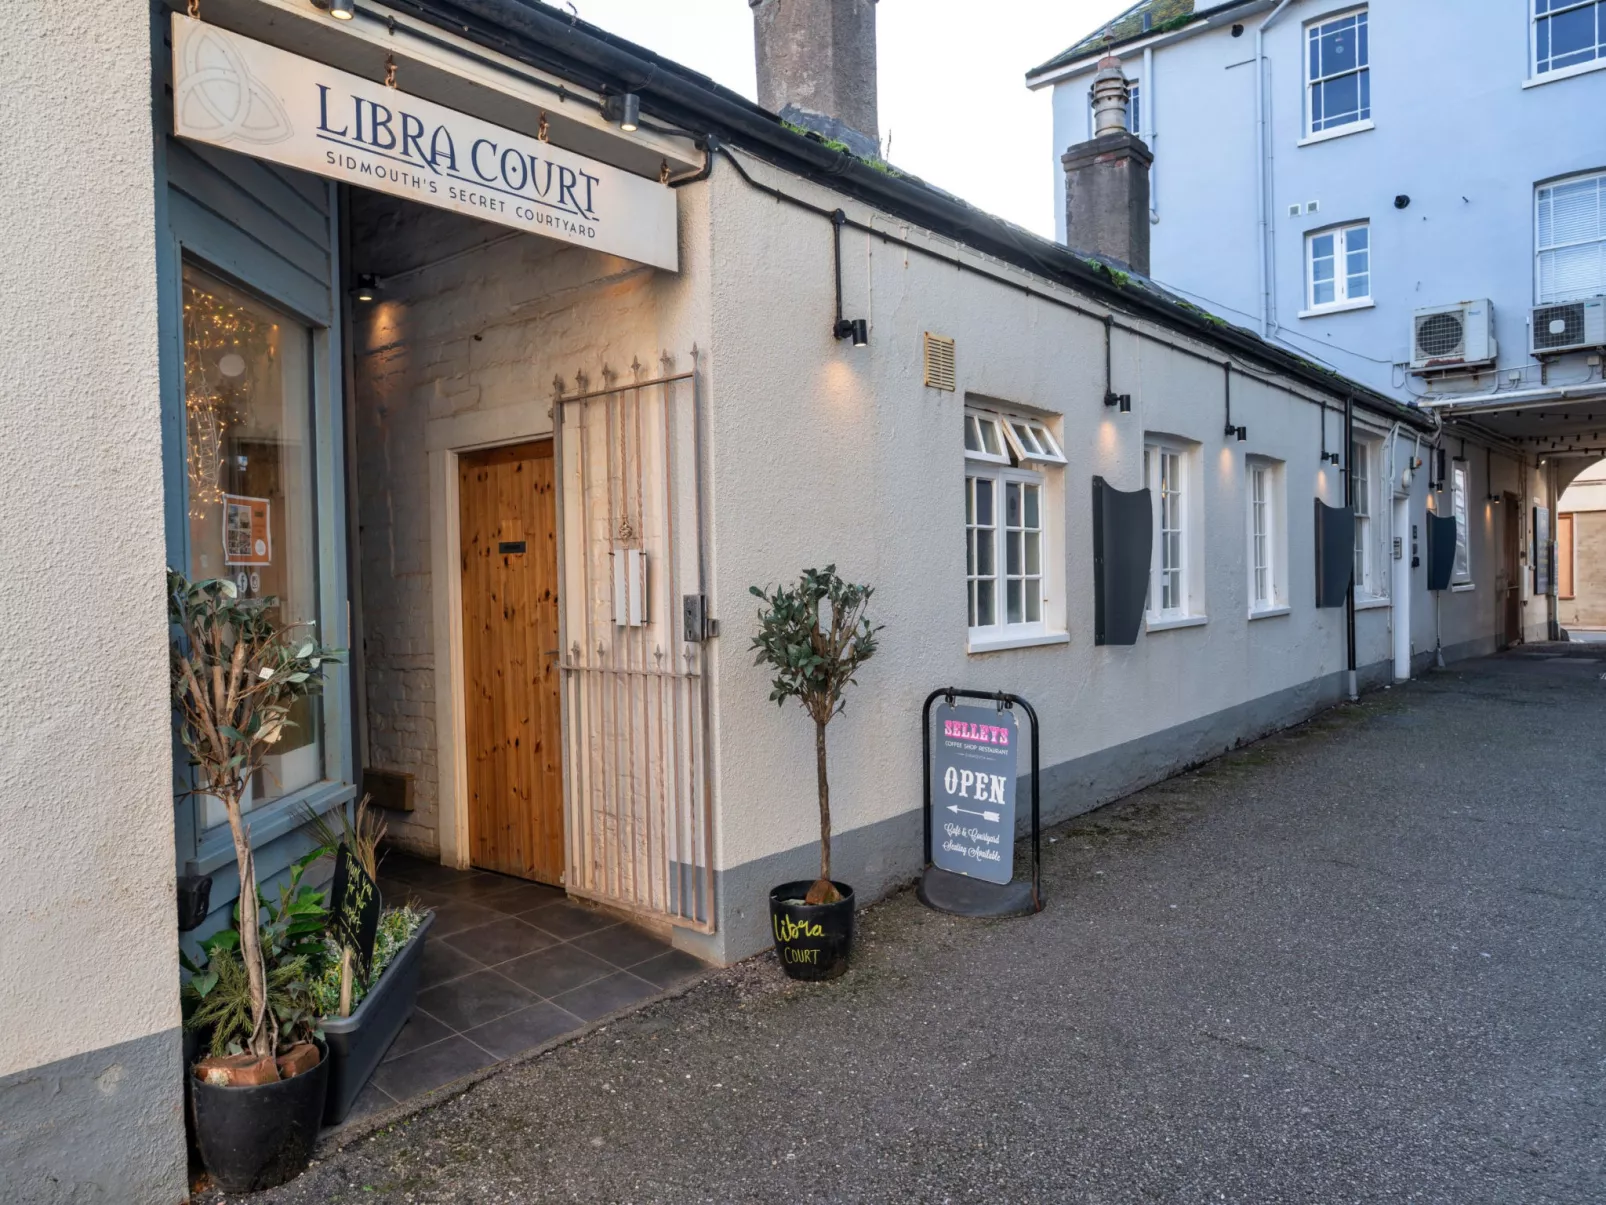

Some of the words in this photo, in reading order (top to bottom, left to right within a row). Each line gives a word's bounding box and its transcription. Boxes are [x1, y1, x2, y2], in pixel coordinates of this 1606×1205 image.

[315, 83, 460, 176] LIBRA
[471, 139, 600, 220] COURT
[326, 151, 438, 194] SIDMOUTH'S
[449, 186, 505, 213] SECRET
[515, 206, 596, 239] COURTYARD
[944, 719, 1009, 745] SELLEYS
[944, 740, 963, 749] COFFEE
[964, 743, 978, 751] SHOP
[978, 745, 1009, 756] RESTAURANT
[944, 766, 1007, 805] OPEN
[961, 827, 968, 838] &
[968, 828, 1000, 845] Courtyard
[942, 839, 967, 857] Seating
[968, 845, 1001, 862] Available
[784, 946, 821, 965] COURT
